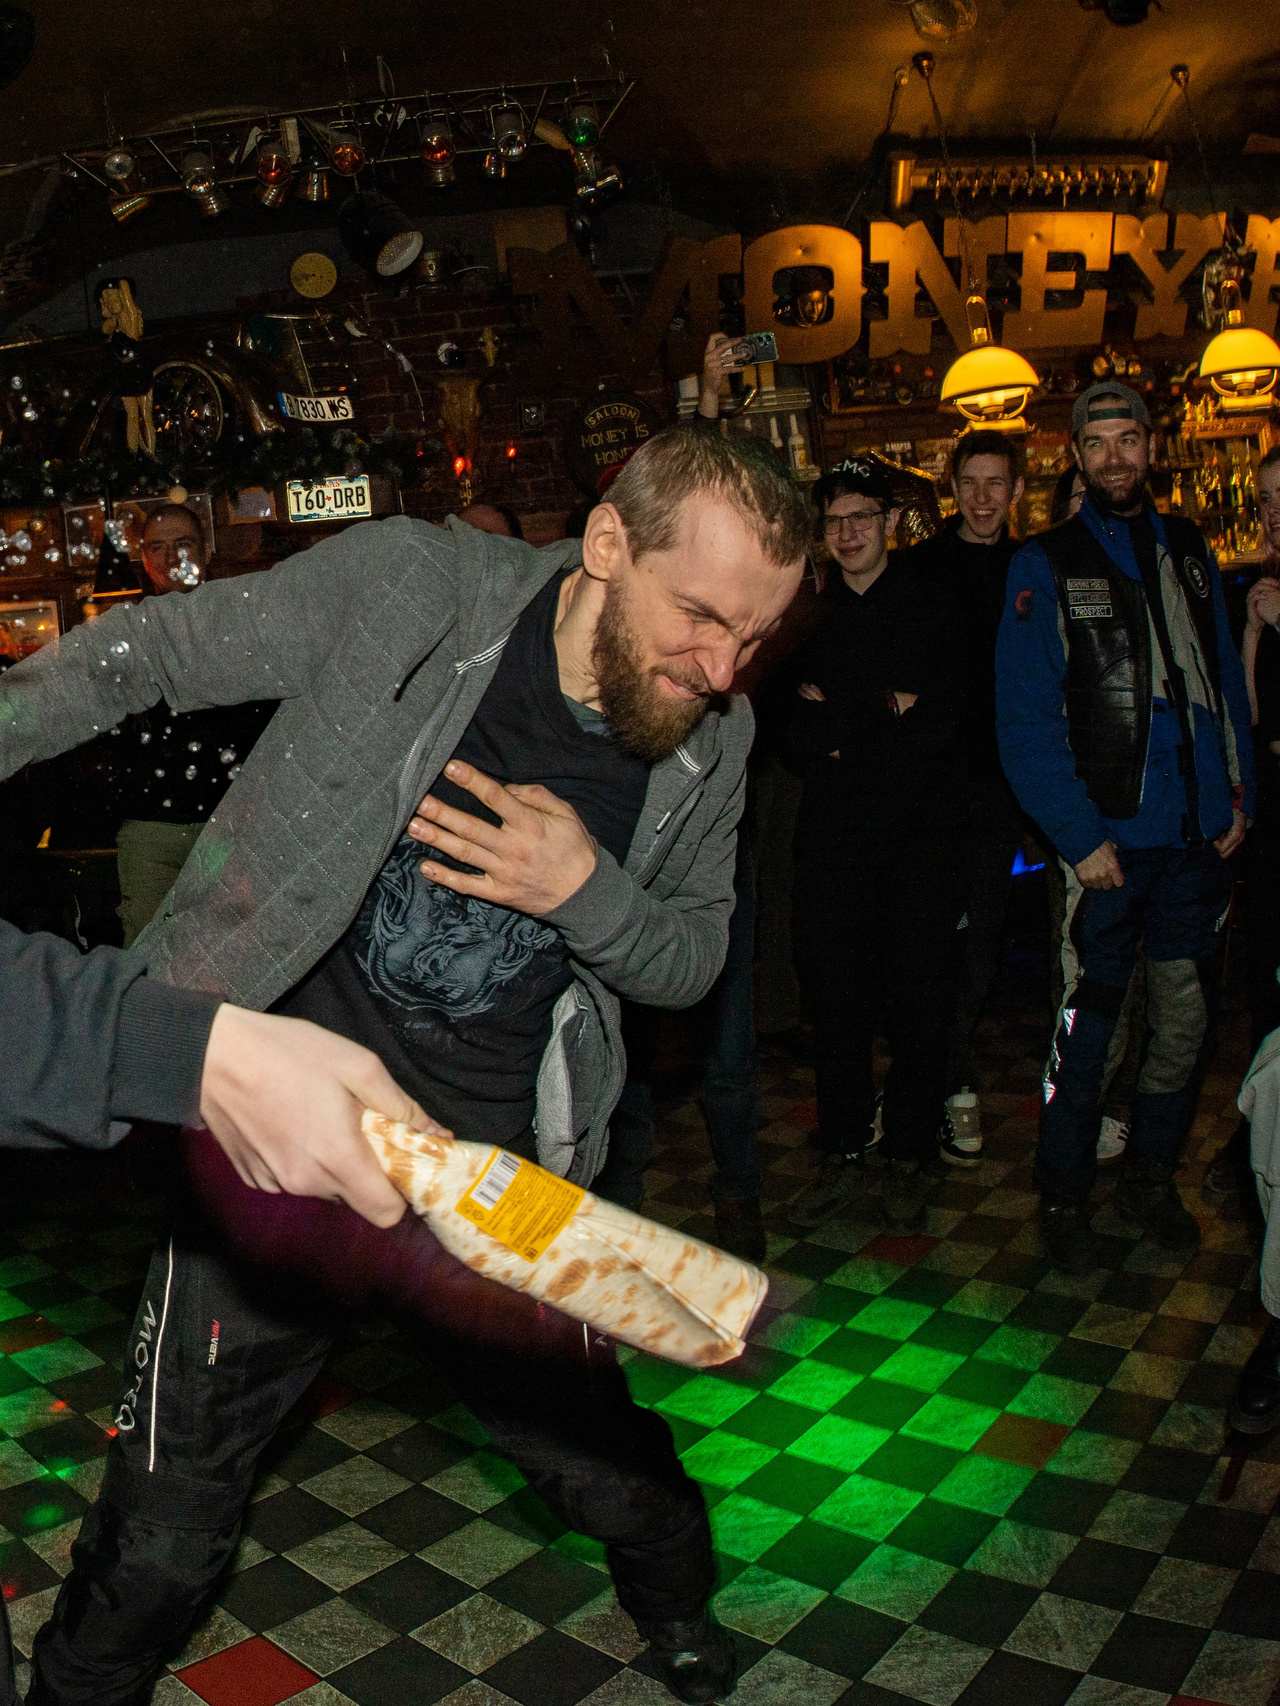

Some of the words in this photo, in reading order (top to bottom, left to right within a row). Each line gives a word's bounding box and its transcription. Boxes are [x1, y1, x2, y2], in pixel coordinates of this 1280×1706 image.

[500, 208, 1228, 383] MONEY
[587, 406, 637, 426] SALOON
[581, 428, 628, 448] MONEY
[634, 424, 649, 438] IS
[1074, 607, 1107, 617] PROSPECT
